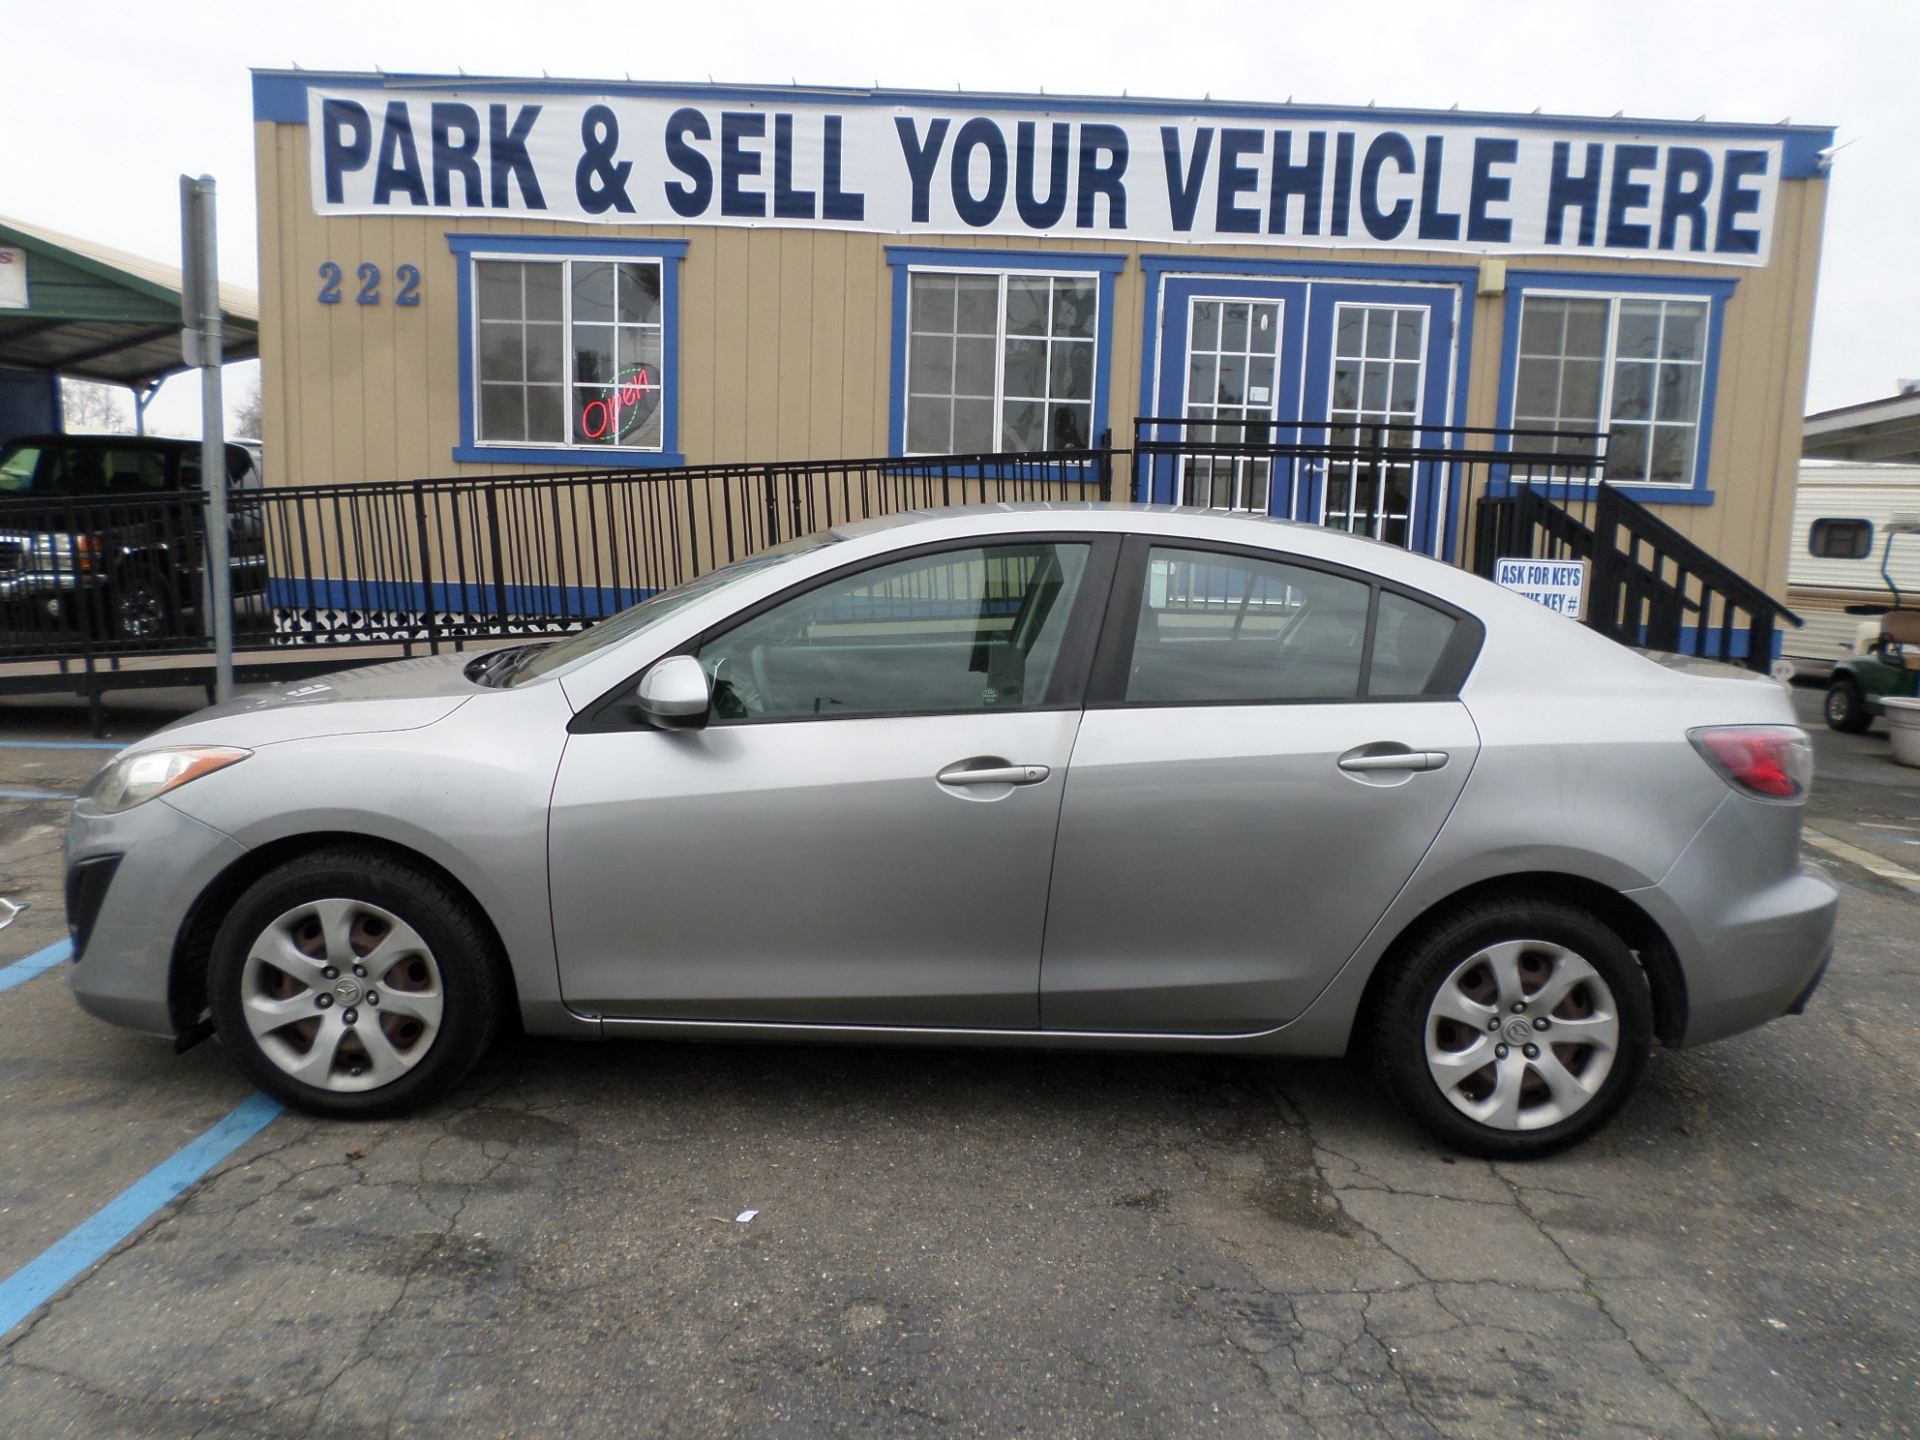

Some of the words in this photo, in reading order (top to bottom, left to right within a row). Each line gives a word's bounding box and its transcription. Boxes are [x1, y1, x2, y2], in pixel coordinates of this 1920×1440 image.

[322, 98, 549, 211] PARK
[575, 103, 637, 215] &
[664, 107, 866, 223] SELL
[894, 116, 1131, 231] YOUR
[1160, 126, 1519, 244] VEHICLE
[1544, 141, 1769, 255] HERE
[318, 261, 422, 307] 222
[582, 368, 651, 438] Open
[1501, 565, 1526, 584] ASK
[1528, 566, 1550, 586] FOR
[1552, 566, 1581, 587] KEYS
[1543, 593, 1566, 613] KEY
[1567, 596, 1578, 613] #
